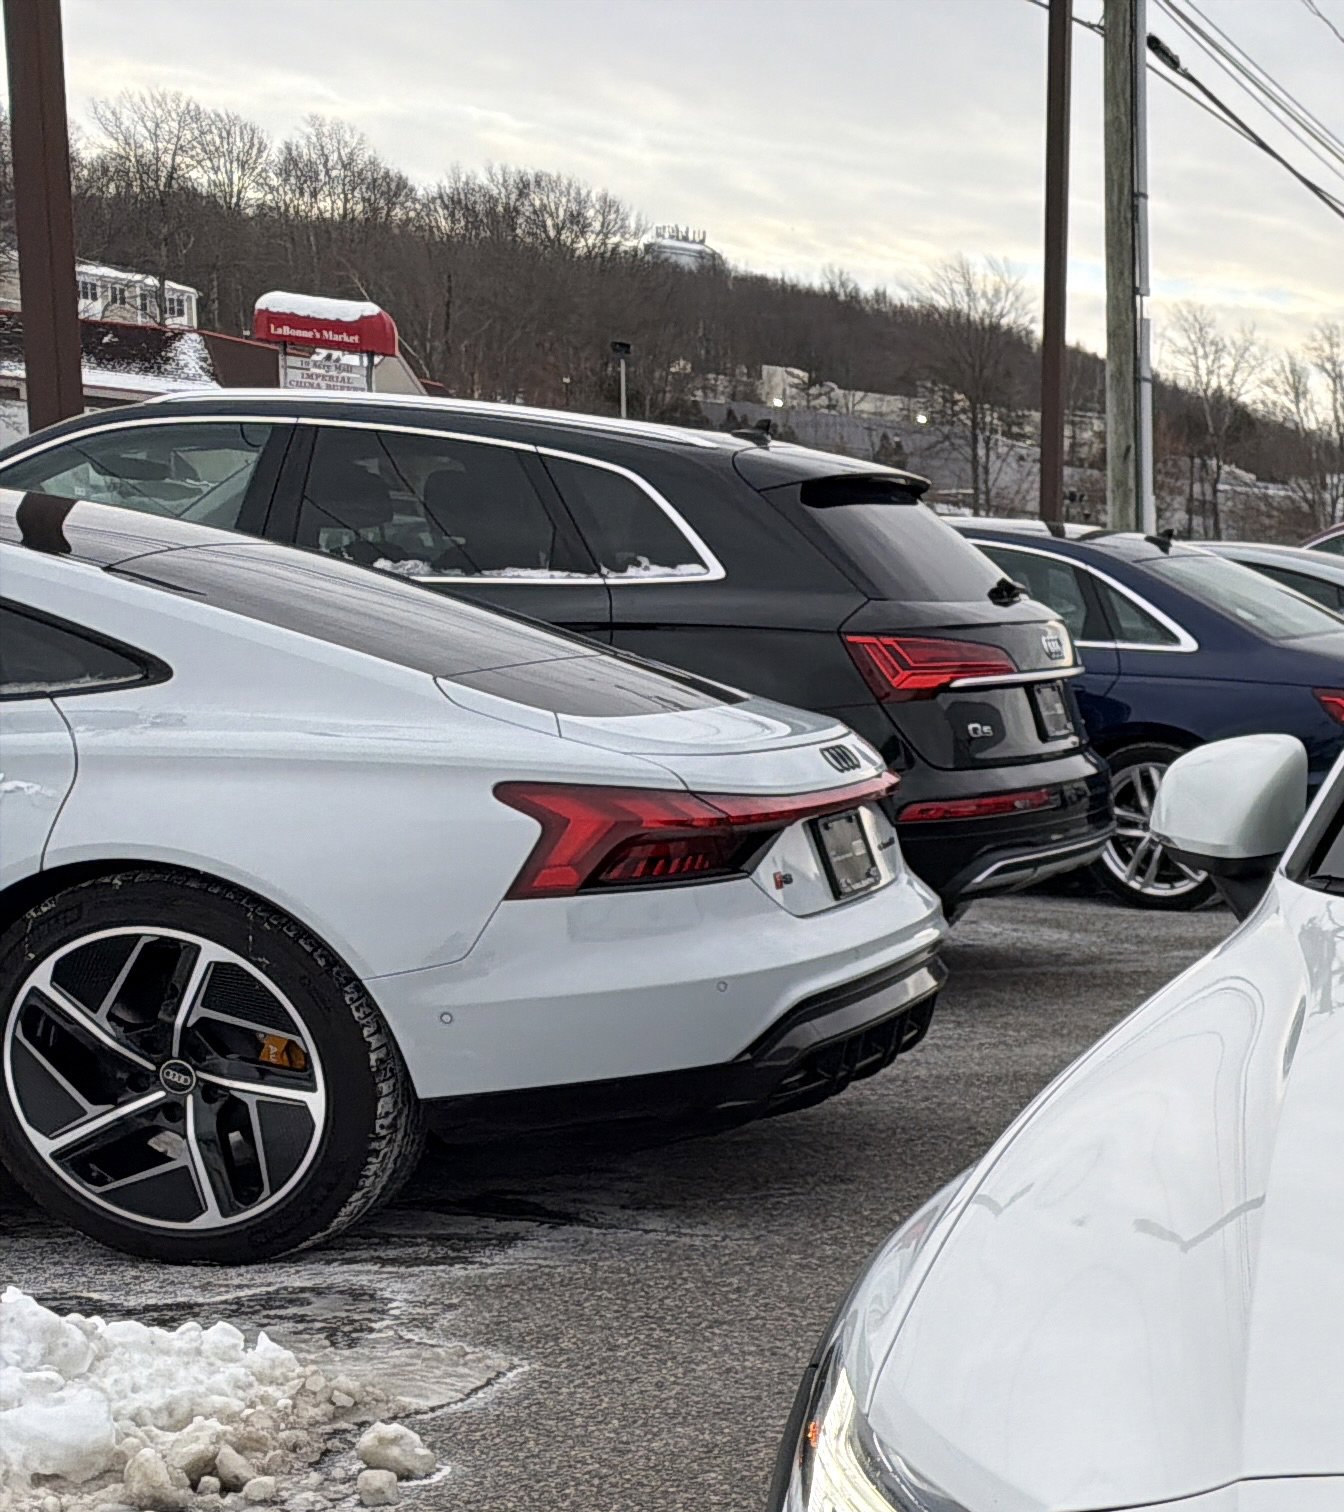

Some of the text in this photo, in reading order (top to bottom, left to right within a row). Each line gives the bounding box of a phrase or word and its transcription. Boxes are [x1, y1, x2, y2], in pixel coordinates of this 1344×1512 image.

[270, 323, 359, 344] LaBonne's Market
[301, 372, 353, 384] IMPERIAL
[288, 379, 321, 390] CHINA
